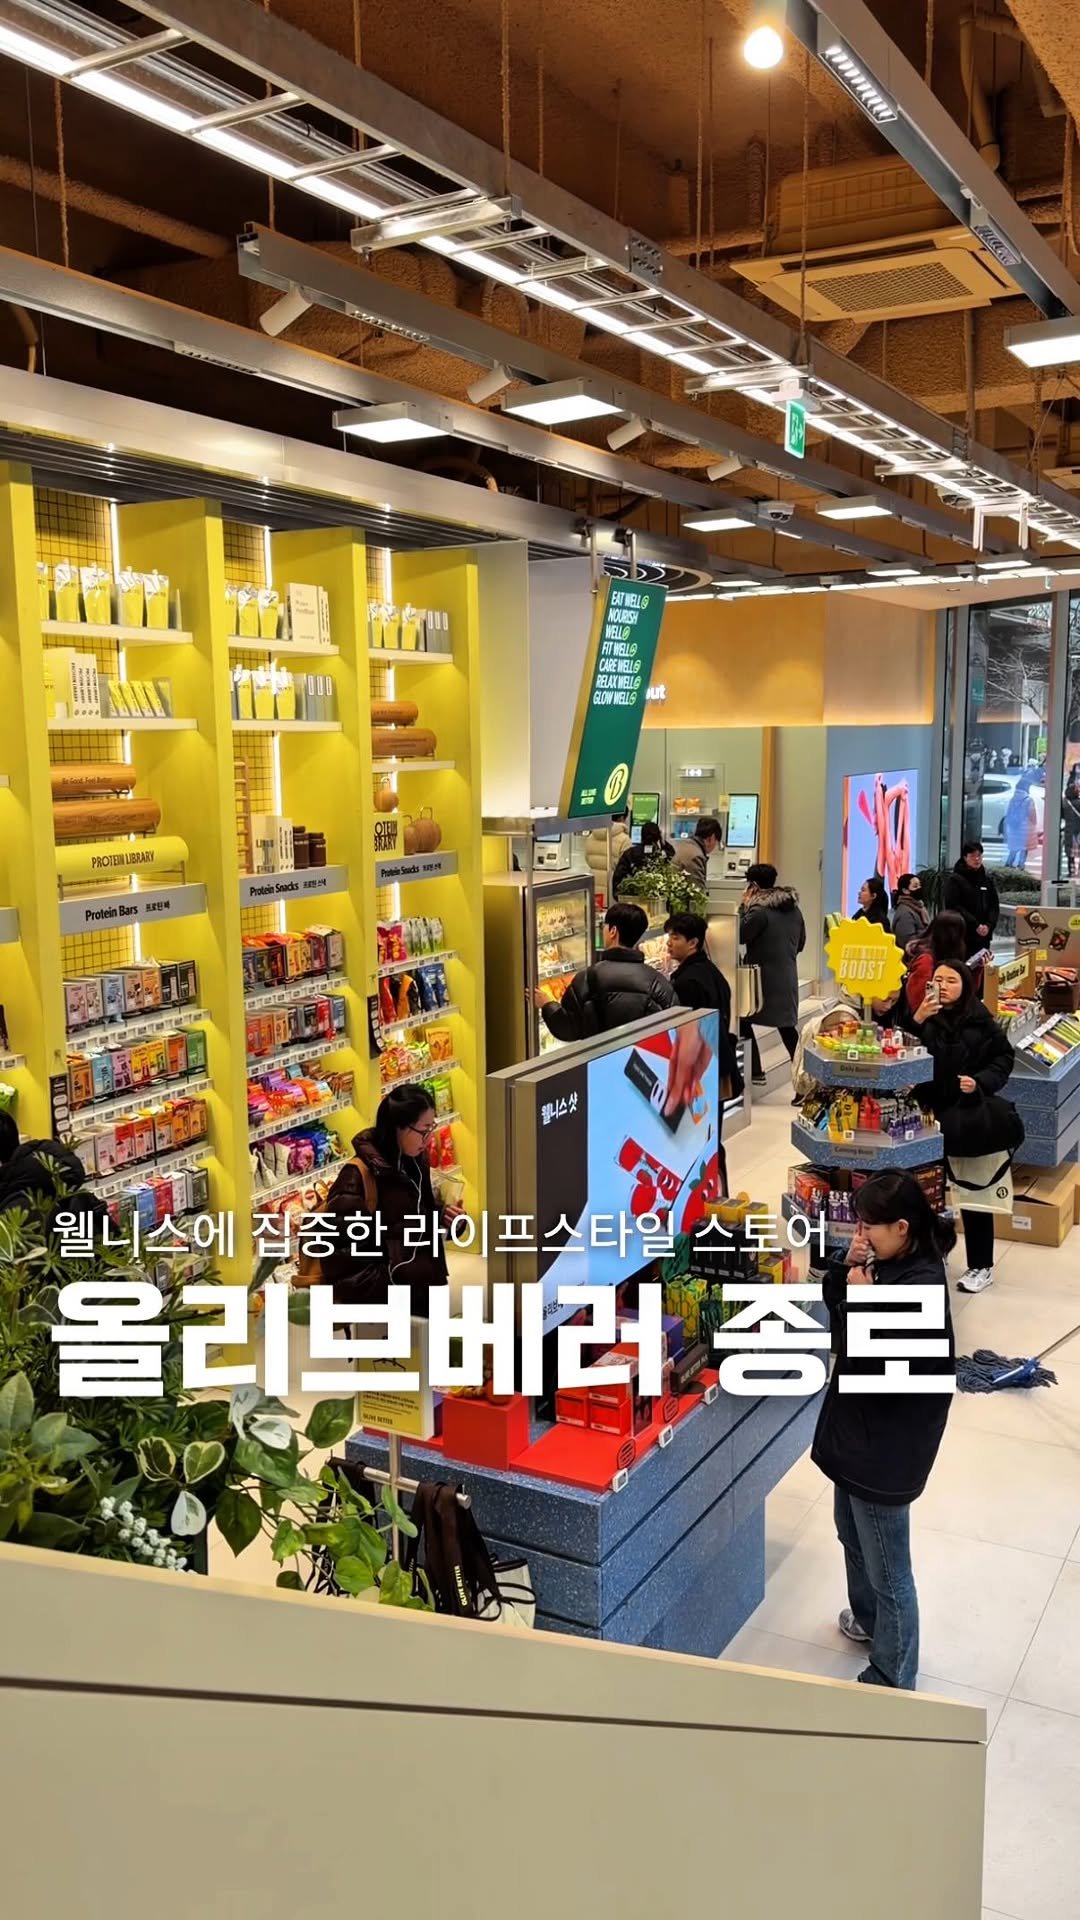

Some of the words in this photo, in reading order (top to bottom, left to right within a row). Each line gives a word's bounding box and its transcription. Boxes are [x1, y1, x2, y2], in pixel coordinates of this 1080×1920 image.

[611, 591, 625, 606] EAT
[625, 593, 641, 609] WELL
[607, 607, 639, 625] NOURISH
[605, 624, 623, 640] WELL
[601, 641, 614, 656] FIT
[614, 642, 630, 657] WELL
[599, 658, 617, 672] CARE
[617, 660, 634, 674] WELL
[595, 674, 618, 689] RELAX
[618, 675, 635, 690] WELL
[593, 691, 614, 704] GLOW
[613, 692, 630, 705] WELL
[645, 684, 666, 700] out
[374, 820, 398, 837] OTEIN
[92, 855, 125, 869] PROTEIN
[126, 850, 155, 864] LIBRARY
[381, 866, 400, 878] Protein
[400, 864, 419, 875] Snacks
[250, 885, 275, 897] Protein
[275, 882, 299, 894] Snacks
[85, 906, 118, 922] Protein
[118, 904, 138, 916] Bars
[840, 961, 885, 980] BOOST
[541, 1097, 568, 1126] 웰니스
[568, 1091, 578, 1112] 샷
[458, 1586, 468, 1606] OLIVE
